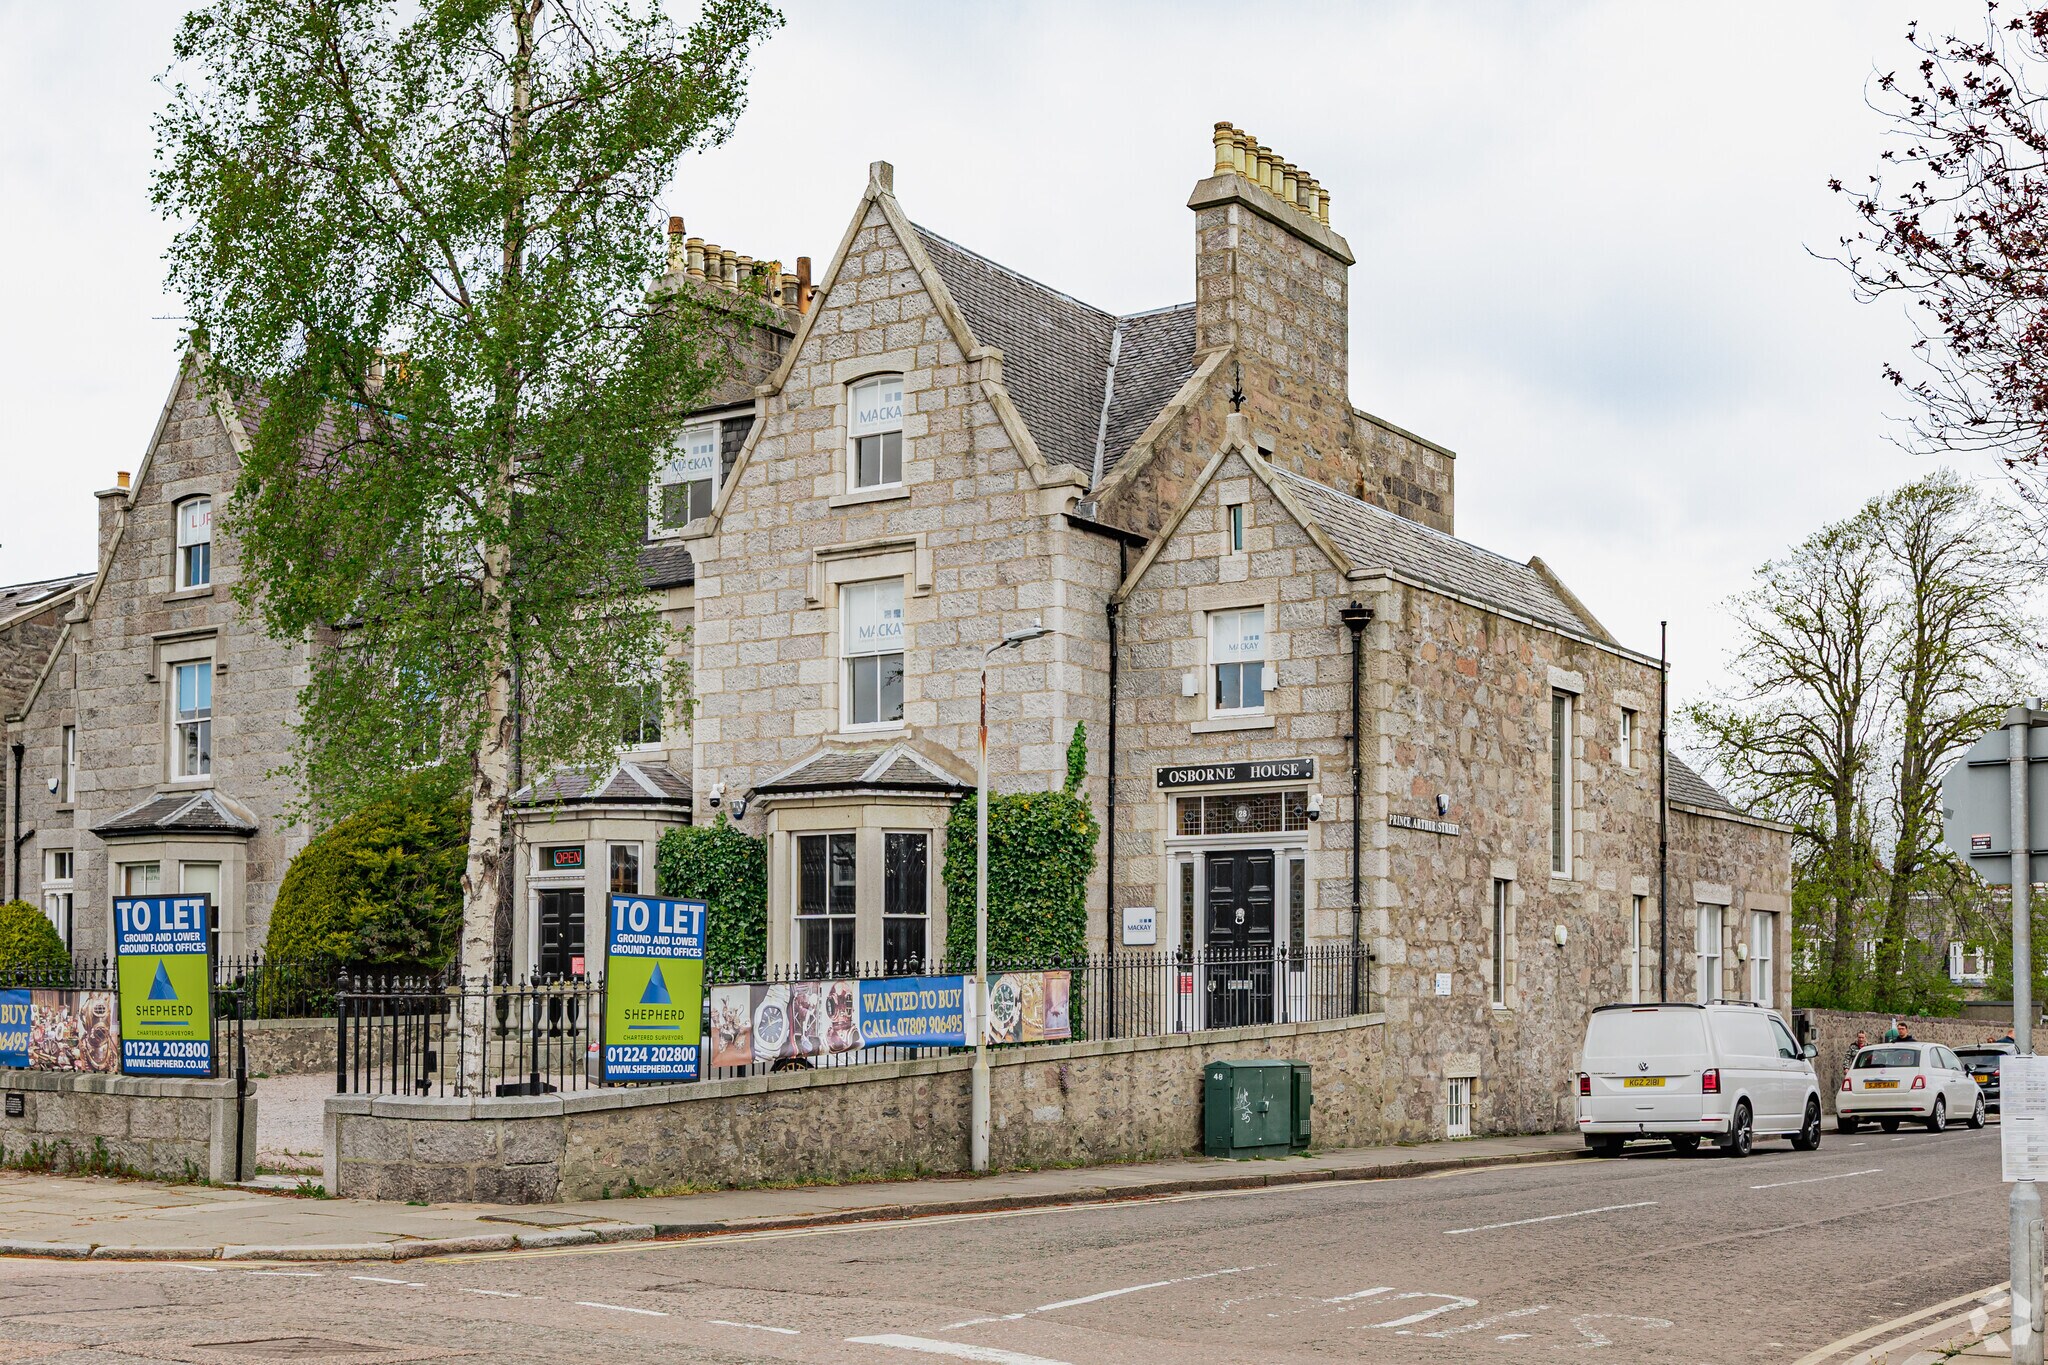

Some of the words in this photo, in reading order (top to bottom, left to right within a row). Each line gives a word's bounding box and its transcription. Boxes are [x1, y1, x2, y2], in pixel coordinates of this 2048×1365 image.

[1168, 766, 1236, 784] OSBORNE
[1250, 763, 1300, 779] HOUSE
[1238, 809, 1247, 818] 28
[1389, 814, 1411, 828] PRINCE
[1413, 817, 1436, 831] ARTHUR
[1437, 821, 1460, 835] STREET
[555, 851, 581, 864] OPEN
[117, 901, 151, 932] TO
[159, 899, 205, 930] LET
[613, 899, 650, 932] TO
[658, 902, 704, 935] LET
[123, 933, 154, 943] GROUND
[155, 932, 172, 942] AND
[173, 932, 201, 942] LOWER
[616, 933, 651, 944] GROUND
[652, 935, 670, 945] AND
[672, 936, 698, 947] LOWER
[119, 943, 149, 953] GROUND
[150, 943, 174, 953] FLOOR
[175, 942, 207, 952] OFFICES
[610, 944, 645, 955] GROUND
[646, 945, 672, 956] FLOOR
[673, 947, 702, 957] OFFICES
[862, 990, 919, 1013] WANTED
[919, 990, 937, 1010] TO
[938, 989, 962, 1009] BUY
[0, 1004, 29, 1025] BUY
[135, 1005, 193, 1016] SHEPHERD
[624, 1008, 685, 1021] SHEPHERD
[862, 1019, 897, 1038] CALL:
[897, 1016, 927, 1037] 07809
[928, 1014, 963, 1034] 906495
[0, 1031, 29, 1051] 6495
[125, 1041, 160, 1057] 01224
[162, 1042, 209, 1058] 202800
[607, 1046, 648, 1062] 01224
[650, 1046, 697, 1062] 202800
[125, 1058, 209, 1069] WWW.SHEPHERD.CO.UK
[607, 1064, 695, 1074] WWW.SHEPHERD.CO.UK
[1213, 1073, 1223, 1081] 48
[1629, 1078, 1644, 1087] KGZ
